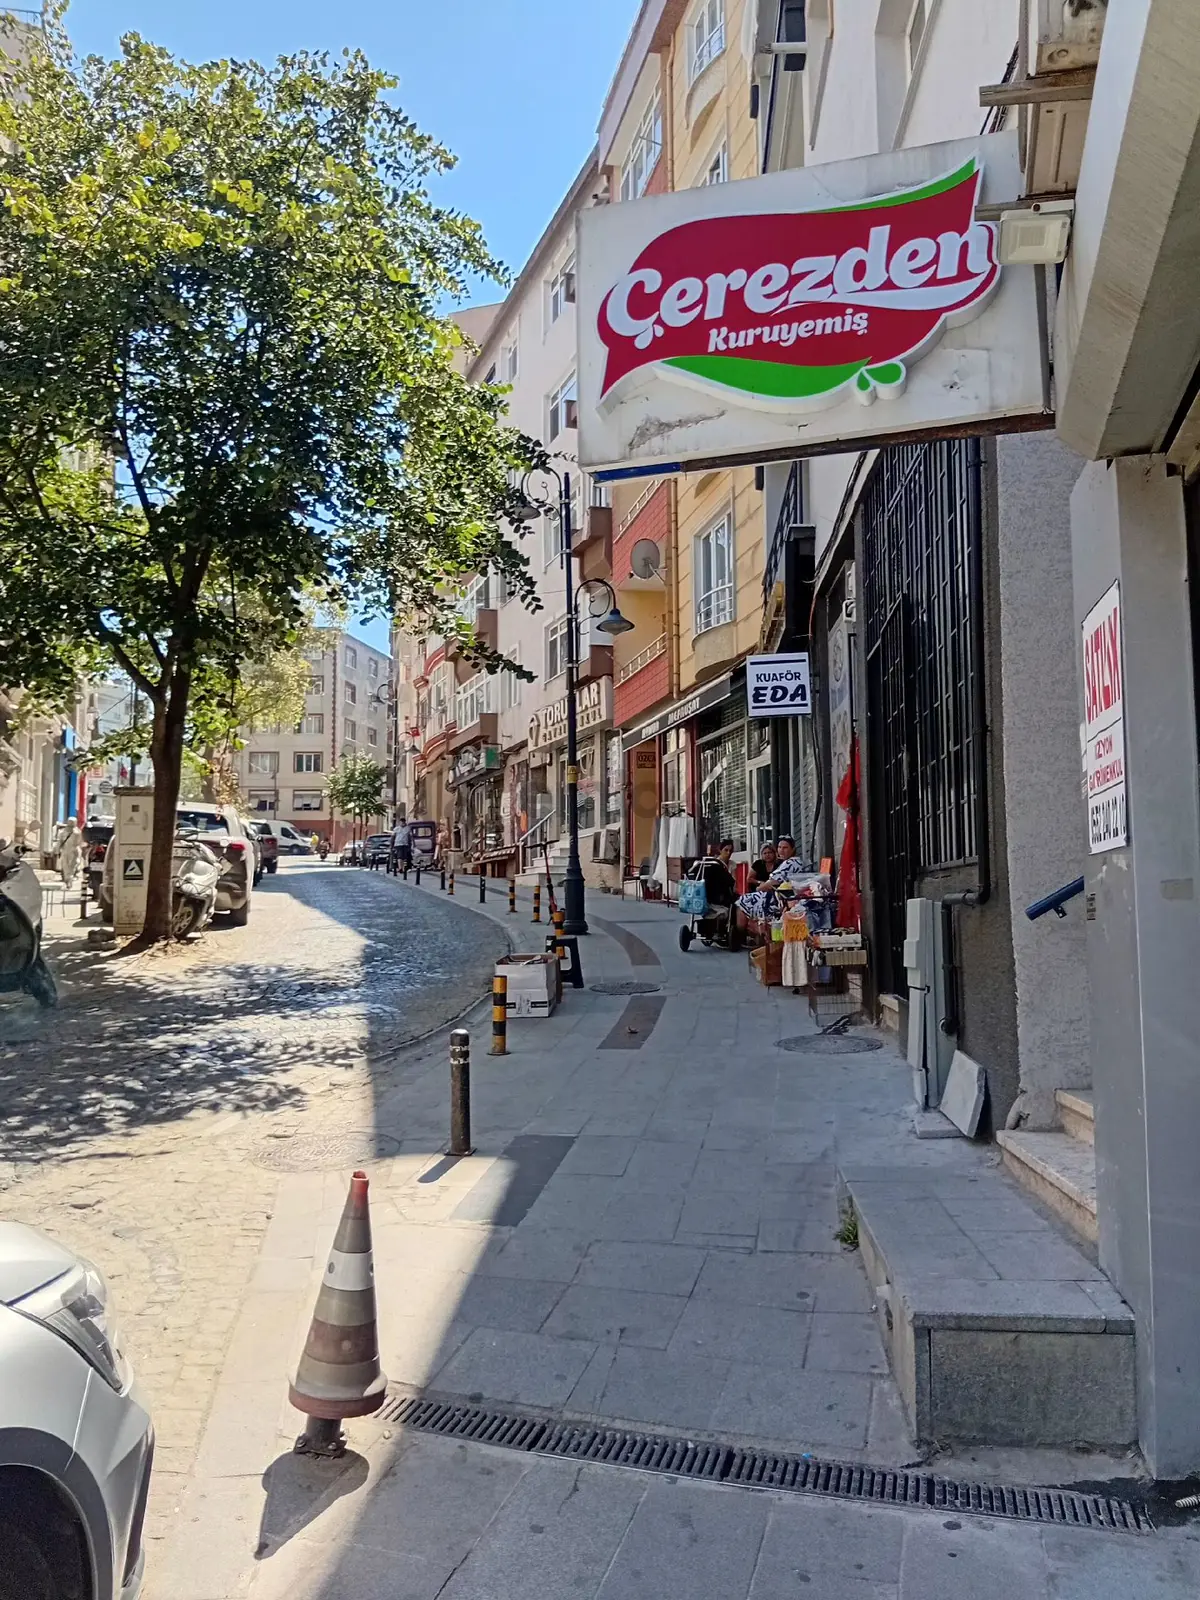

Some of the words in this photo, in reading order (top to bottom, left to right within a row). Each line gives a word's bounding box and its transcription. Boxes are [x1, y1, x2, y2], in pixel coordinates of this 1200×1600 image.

[605, 225, 993, 350] Çerezden
[708, 309, 869, 353] Kuruyemiş
[756, 670, 802, 683] KUAFÖR
[1085, 607, 1120, 723] SATILIK
[540, 682, 600, 727] TORULAR
[752, 684, 807, 704] EDA
